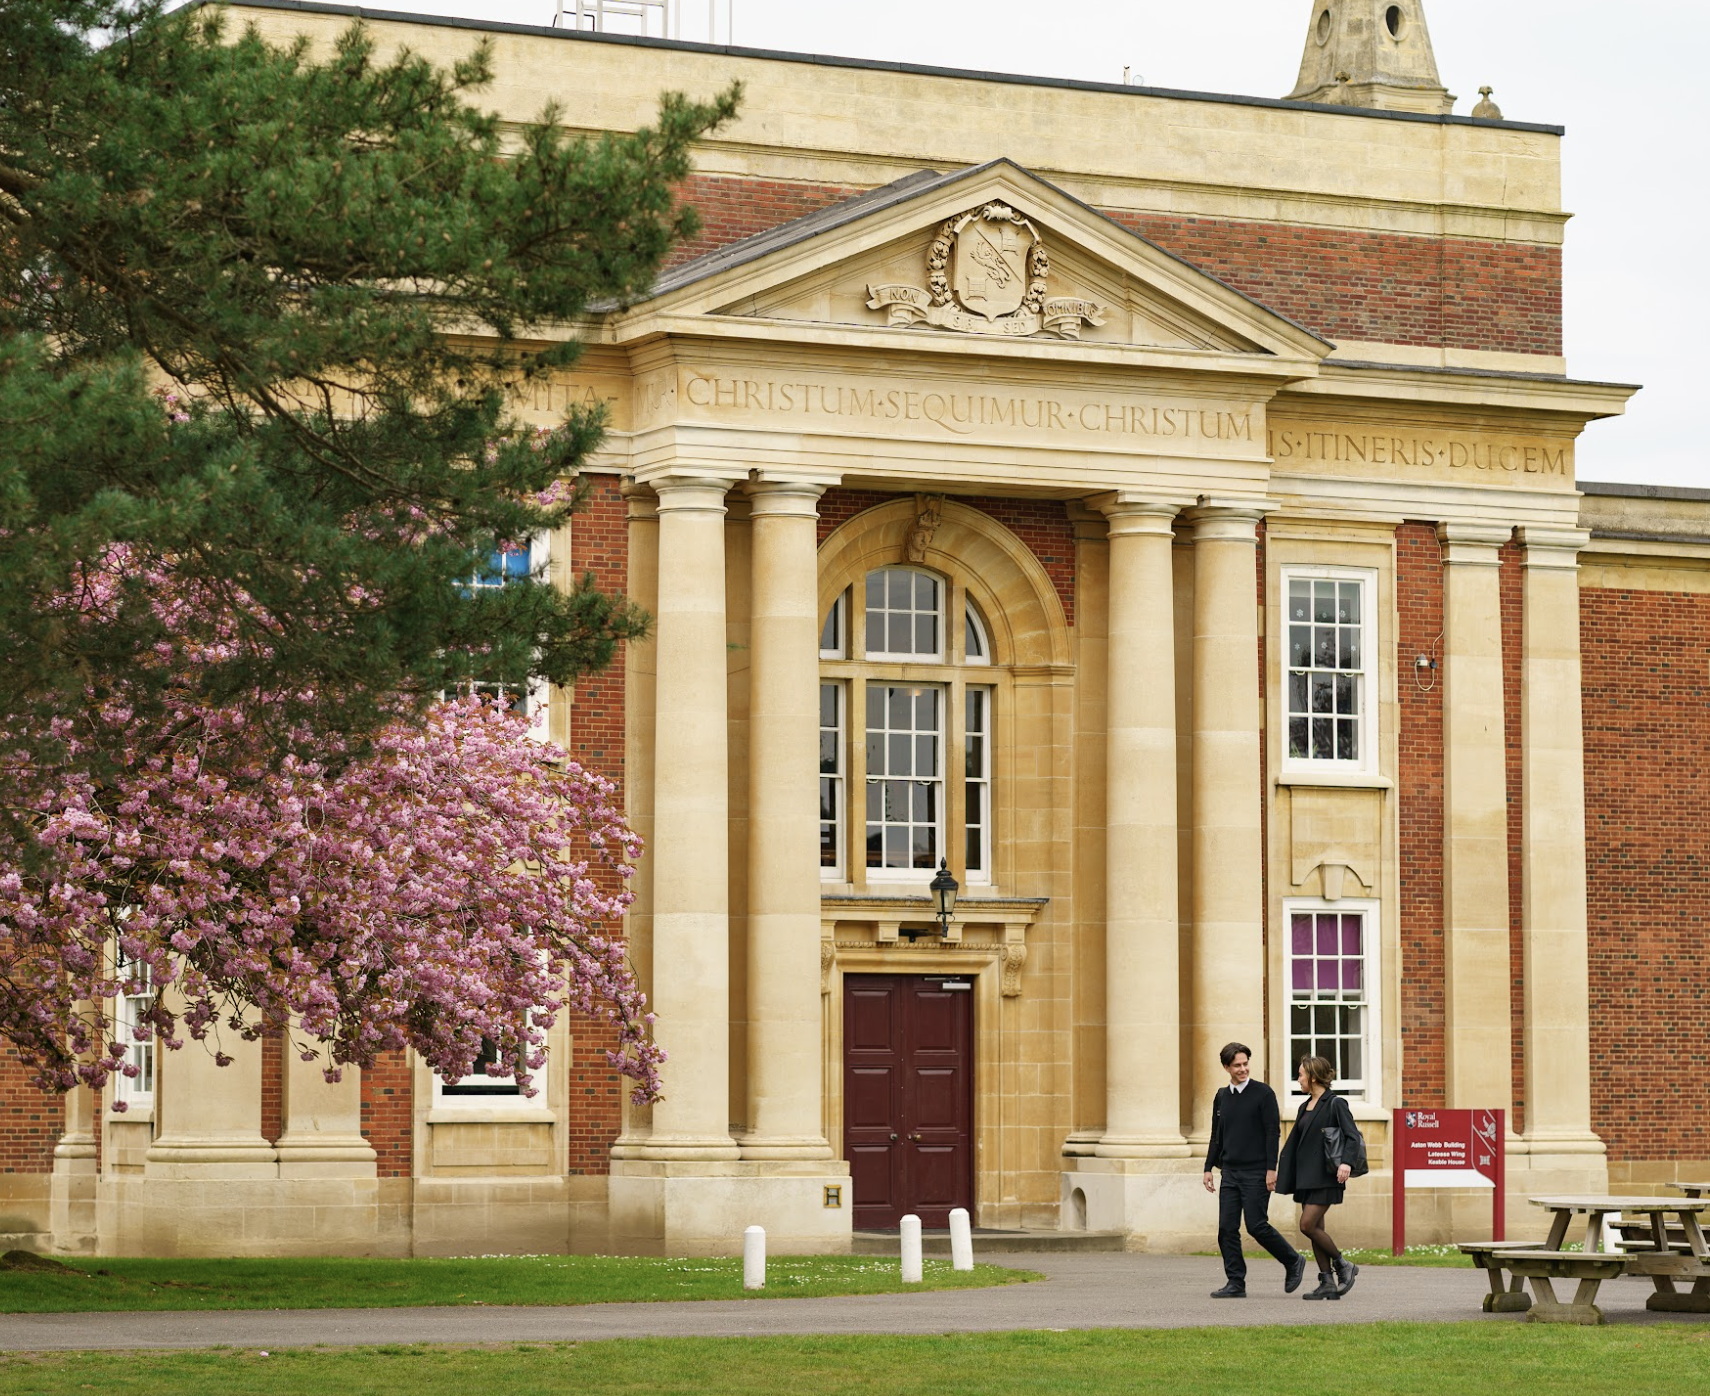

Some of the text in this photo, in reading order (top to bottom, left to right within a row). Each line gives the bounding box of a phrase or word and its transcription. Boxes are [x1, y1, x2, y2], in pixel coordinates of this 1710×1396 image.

[889, 287, 920, 303] NON
[1047, 302, 1096, 320] OMNIBUS
[686, 376, 877, 417] CHRISTUM
[885, 390, 1067, 435] SEQUIMUR
[1079, 406, 1254, 442] CHRISTUM
[1305, 432, 1435, 467] ITINERIS
[1448, 441, 1566, 475] DUCEM
[1418, 1112, 1435, 1122] Royal
[1418, 1120, 1439, 1128] Russell
